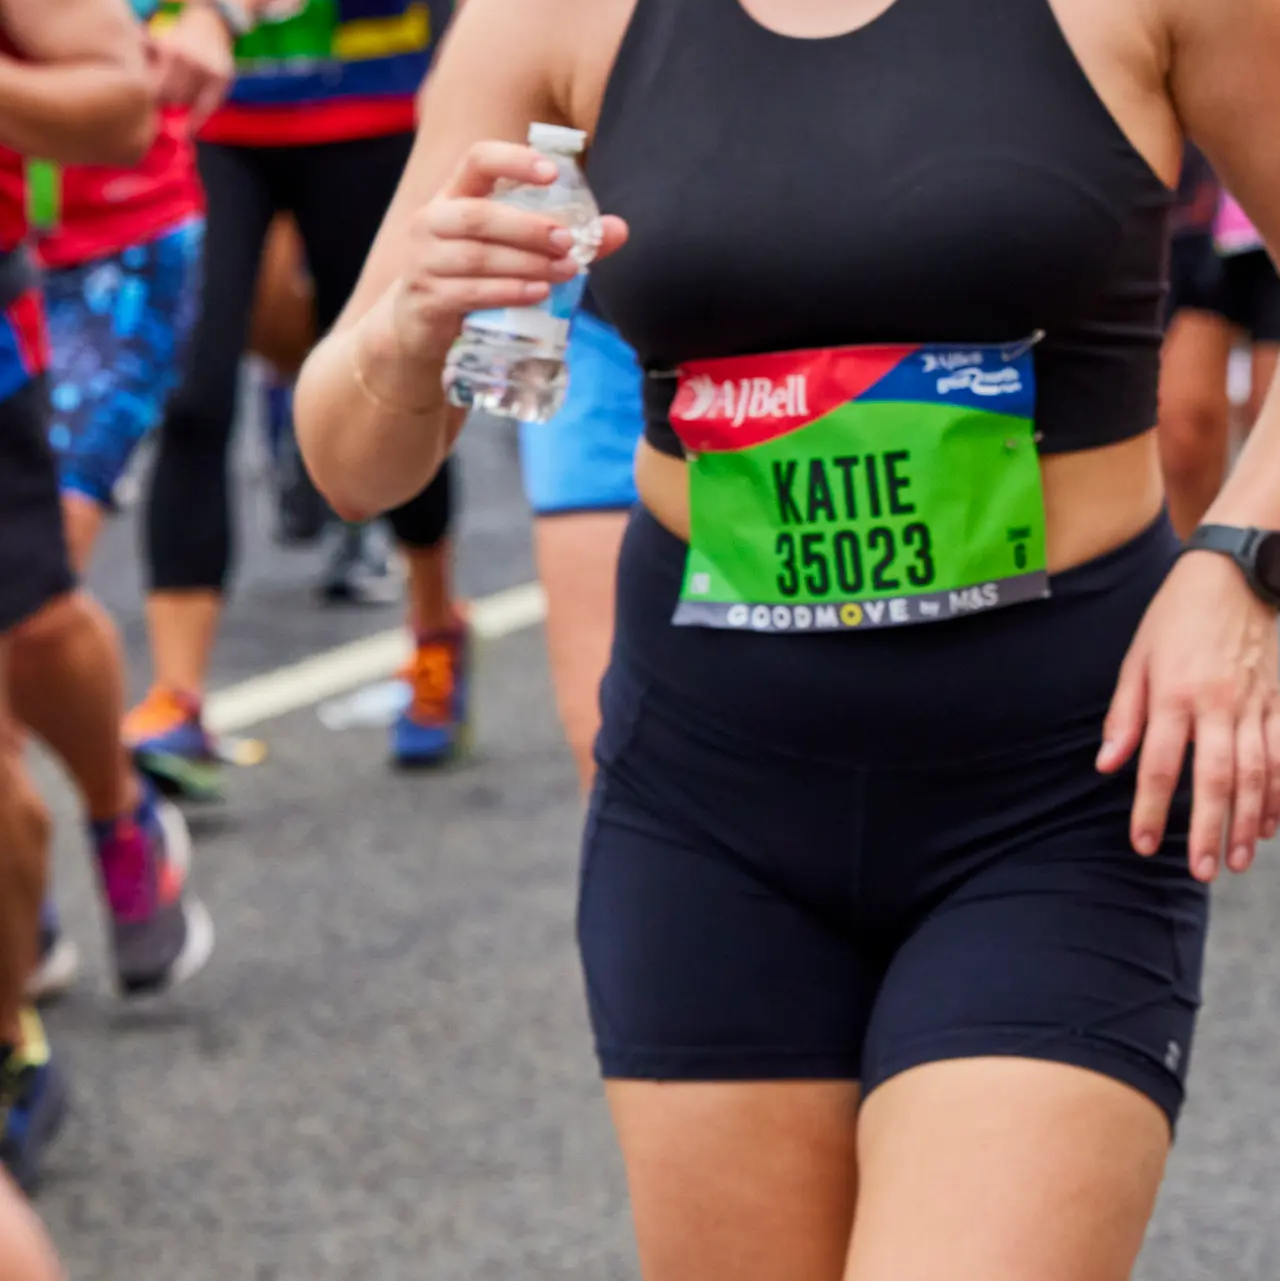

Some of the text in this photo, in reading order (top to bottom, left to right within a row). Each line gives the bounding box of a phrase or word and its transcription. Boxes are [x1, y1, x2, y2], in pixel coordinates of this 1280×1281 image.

[773, 449, 915, 524] KATIE
[775, 522, 935, 598] 35023
[726, 596, 910, 629] GOODMOVE
[948, 582, 999, 613] M&S
